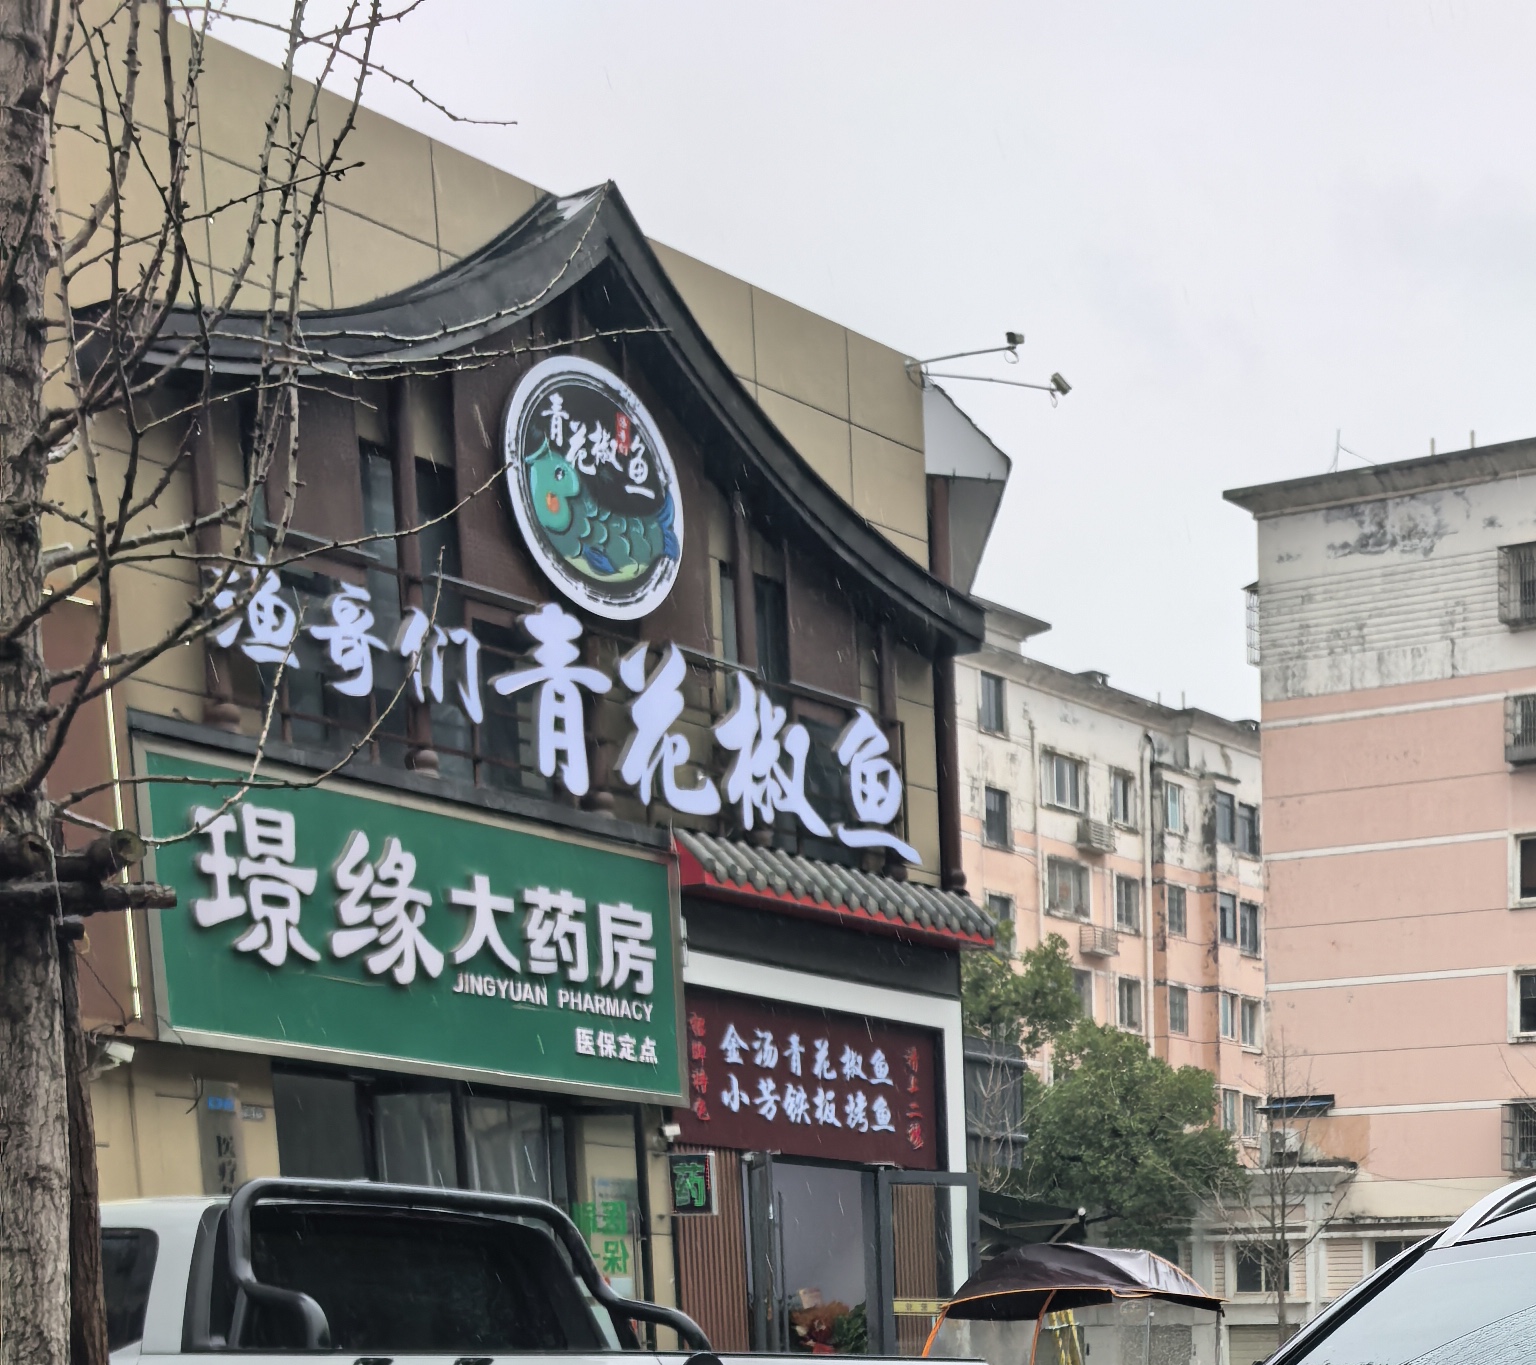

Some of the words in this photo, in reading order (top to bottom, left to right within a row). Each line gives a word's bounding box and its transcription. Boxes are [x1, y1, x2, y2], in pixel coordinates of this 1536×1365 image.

[452, 972, 549, 1007] JINGYUAN
[558, 989, 655, 1022] PHARMACY
[574, 1026, 658, 1064] 医保定点
[719, 1023, 894, 1087] 金汤青花椒鱼
[720, 1073, 896, 1133] 小芳铁板烤鱼
[673, 1162, 706, 1207] 药
